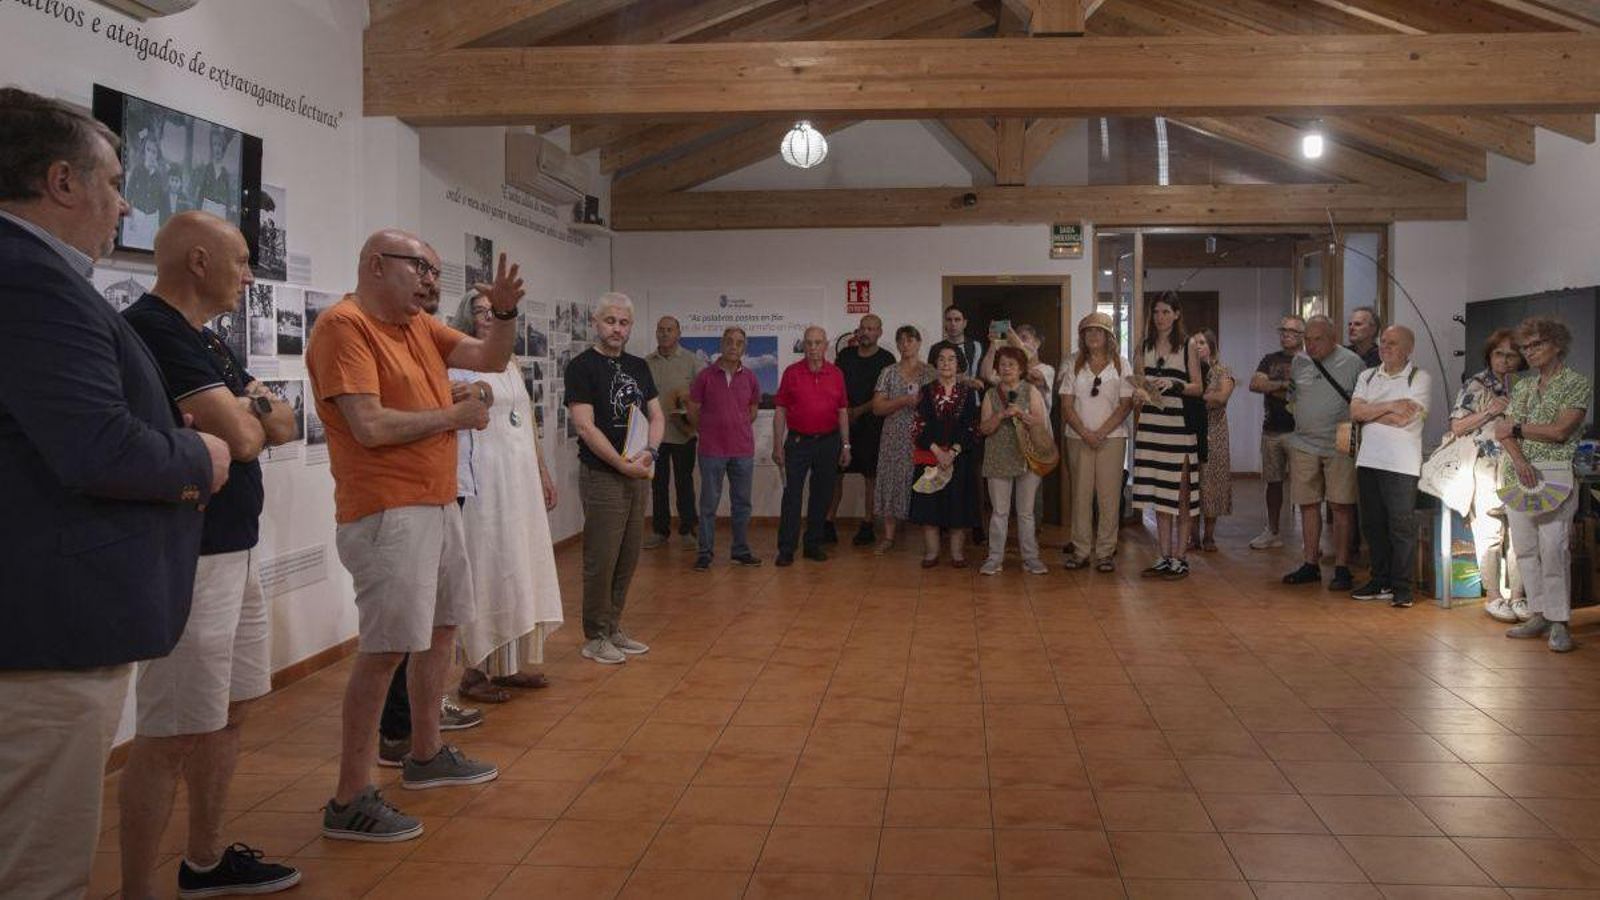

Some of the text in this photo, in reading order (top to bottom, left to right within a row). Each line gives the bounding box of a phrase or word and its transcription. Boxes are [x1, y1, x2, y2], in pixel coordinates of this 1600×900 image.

[92, 17, 101, 33] e
[107, 23, 186, 68] ateigados
[189, 51, 206, 76] de
[209, 66, 296, 114] extravagantes
